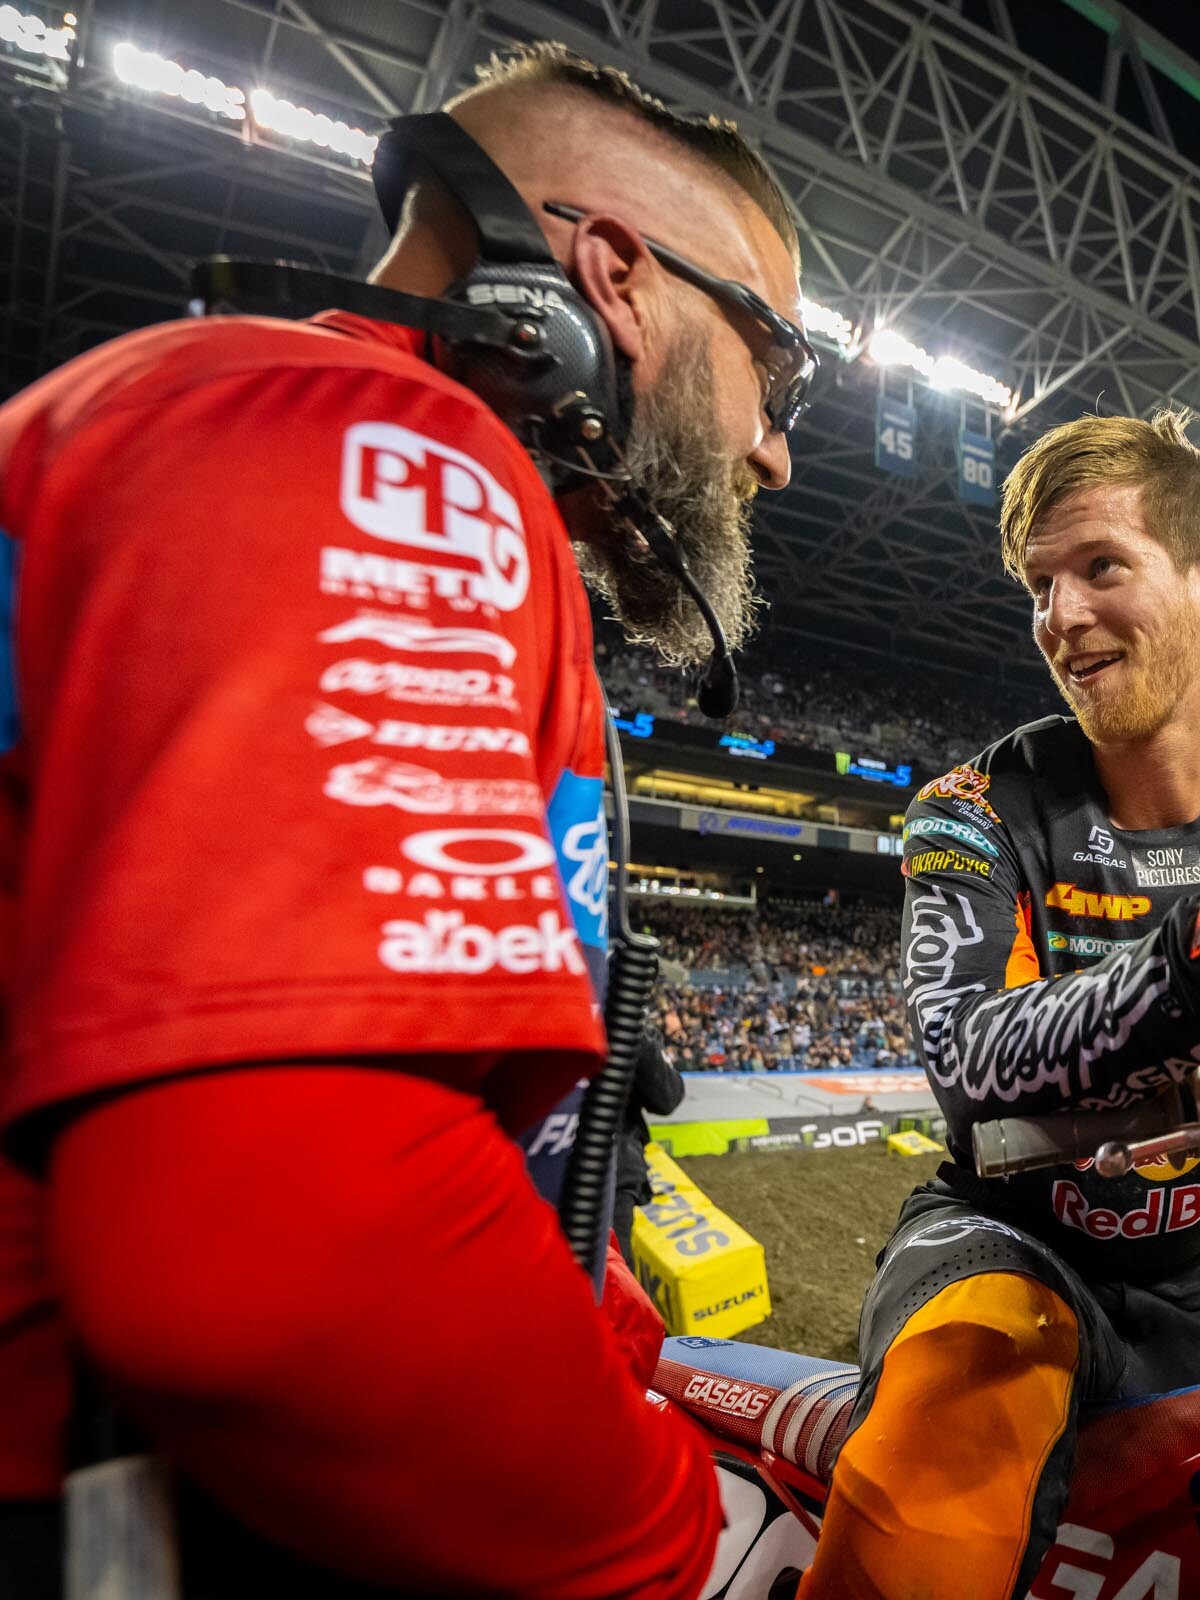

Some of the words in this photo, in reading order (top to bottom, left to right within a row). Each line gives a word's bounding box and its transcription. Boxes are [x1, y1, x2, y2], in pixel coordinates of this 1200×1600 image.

[880, 427, 913, 460] 45
[963, 457, 993, 489] 80
[957, 807, 991, 830] Company
[1073, 851, 1127, 869] GASGAS
[1147, 848, 1183, 868] SONY
[1046, 881, 1152, 921] 4WP
[1052, 1179, 1166, 1240] Red
[692, 1284, 765, 1322] SUZUKI
[684, 1376, 770, 1416] GASGAS
